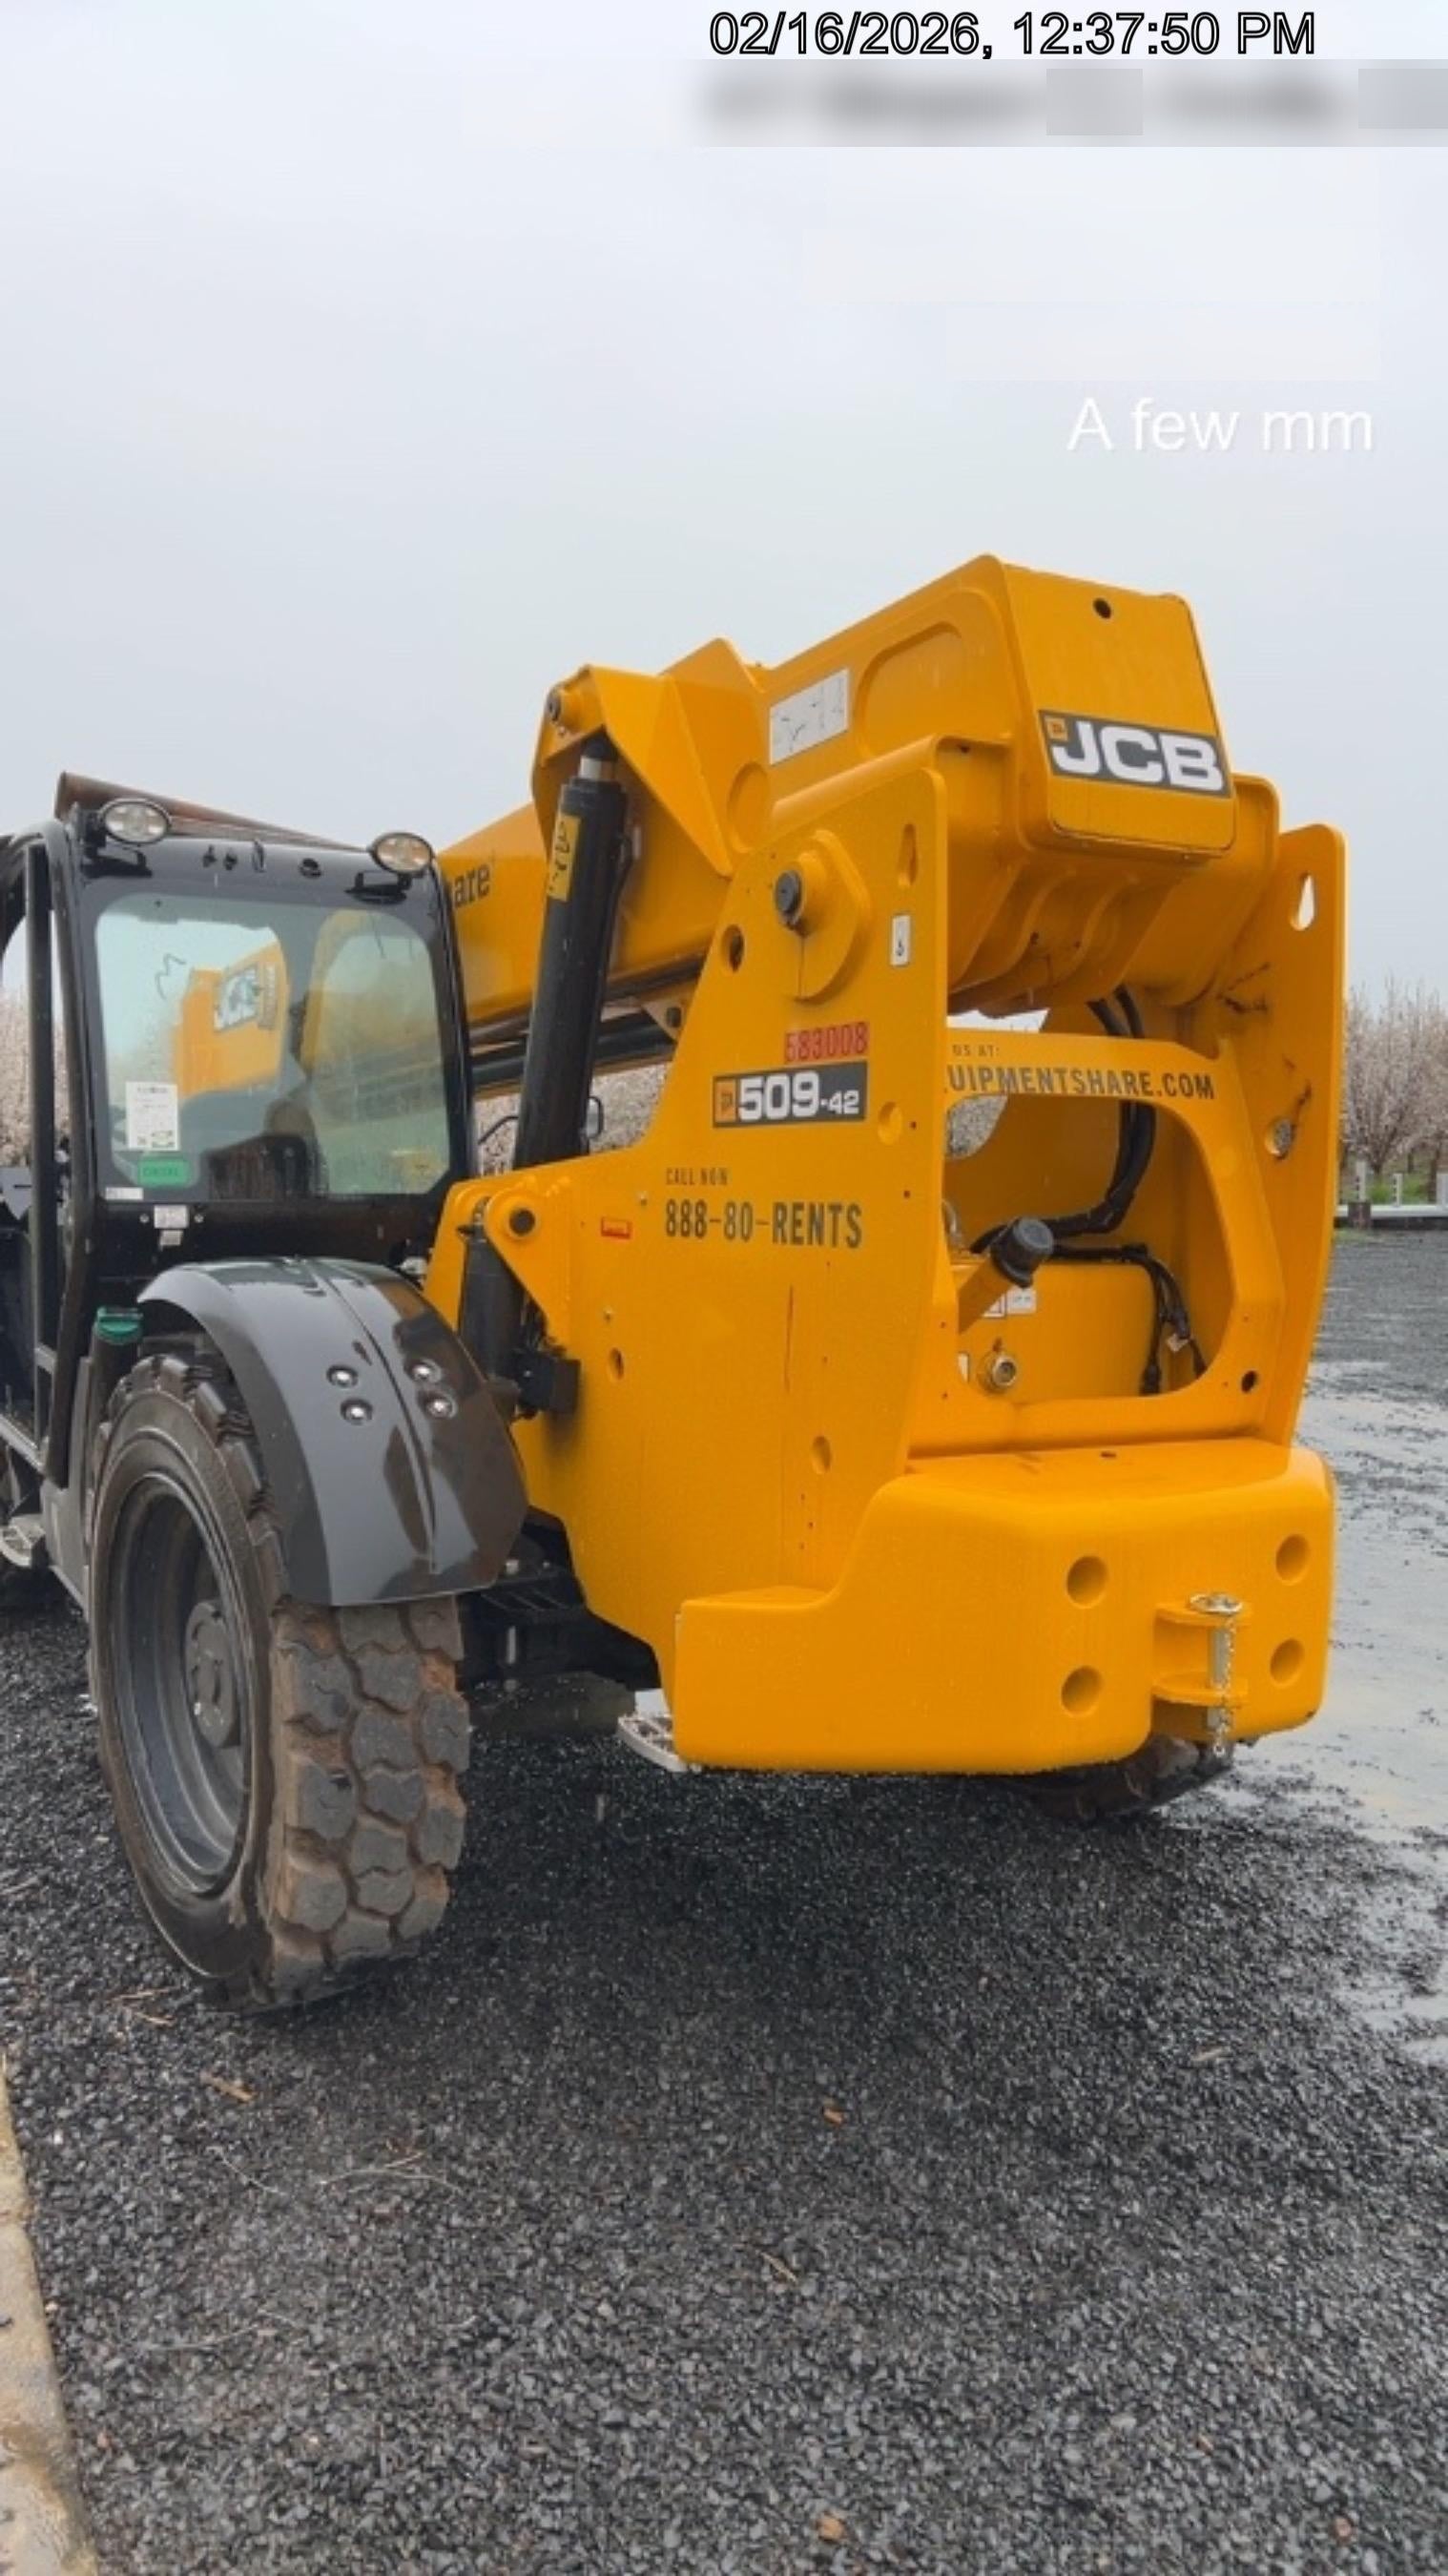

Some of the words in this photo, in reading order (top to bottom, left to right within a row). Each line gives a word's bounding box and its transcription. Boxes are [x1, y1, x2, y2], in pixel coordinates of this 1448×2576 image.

[1051, 719, 1224, 792] JCB
[454, 863, 490, 909] are
[738, 1070, 860, 1122] 509-42
[944, 1064, 1215, 1099] UIPMENTSHARE.COM
[666, 1198, 862, 1248] 888-80-RENTS
